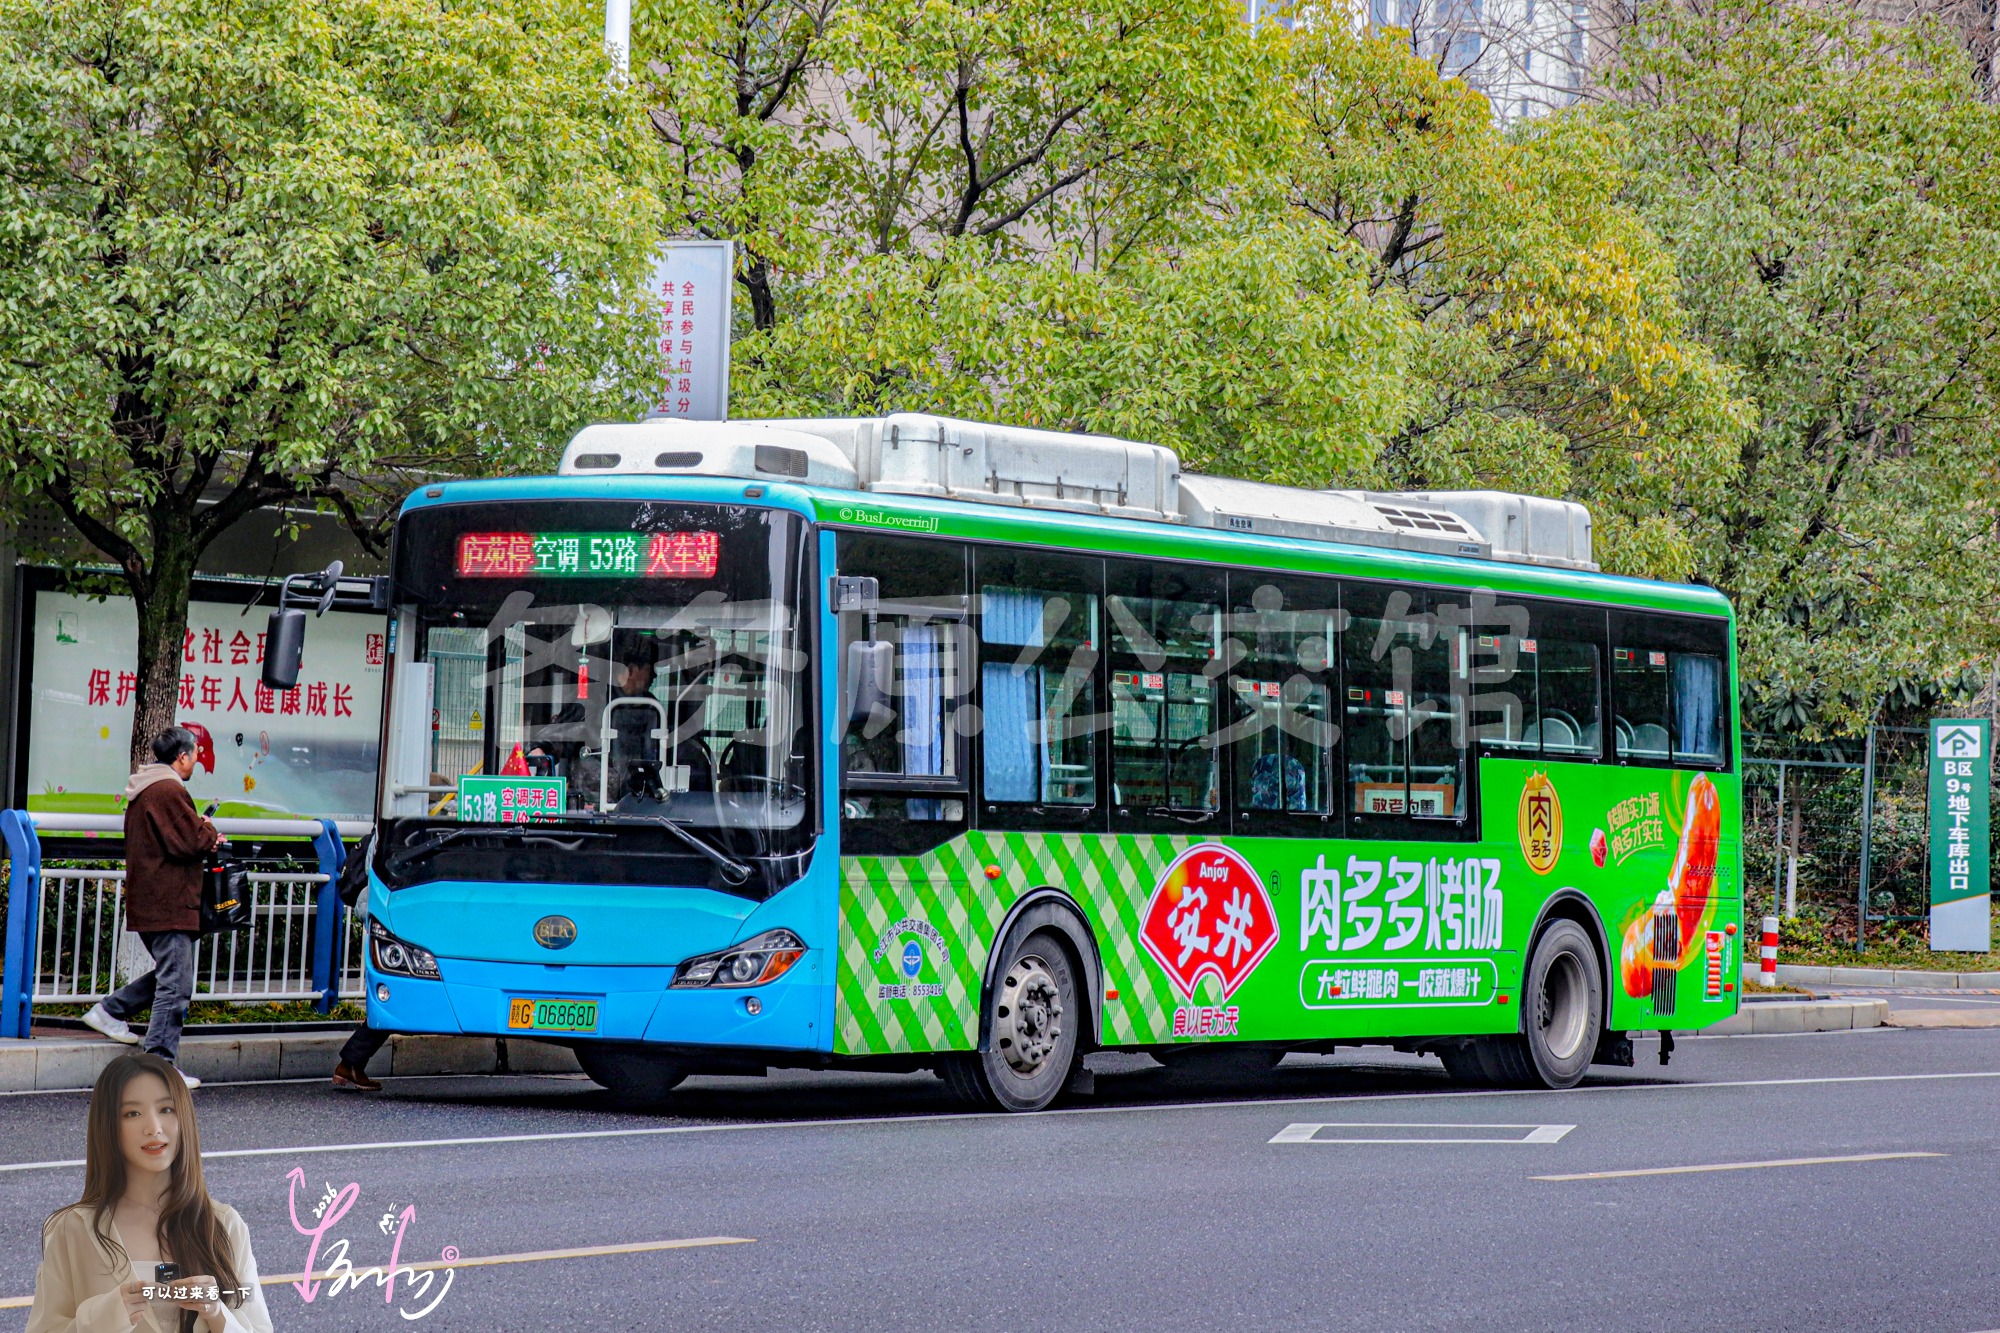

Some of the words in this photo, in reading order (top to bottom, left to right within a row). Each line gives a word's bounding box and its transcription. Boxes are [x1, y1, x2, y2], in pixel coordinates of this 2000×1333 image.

[677, 280, 695, 420] 全民参与垃圾分
[590, 537, 638, 572] 53路
[647, 535, 718, 573] 火车站
[87, 668, 353, 718] 保护成年人健康成长
[464, 791, 497, 822] 53路
[501, 786, 558, 808] 空调开启
[1607, 792, 1660, 834] 烤肠实力派
[1611, 817, 1663, 860] 肉多才实在
[1948, 794, 1971, 890] 地下车库出口
[1199, 856, 1230, 883] Anjoy
[1300, 854, 1503, 951] 肉多多烤肠
[874, 918, 950, 963] 九江市公共交通集团公司
[1167, 886, 1254, 969] 安井
[1317, 969, 1399, 1000] 大粒鲜腿肉
[1402, 968, 1482, 998] 一咬就爆汁
[1173, 1007, 1239, 1036] 食以民为天
